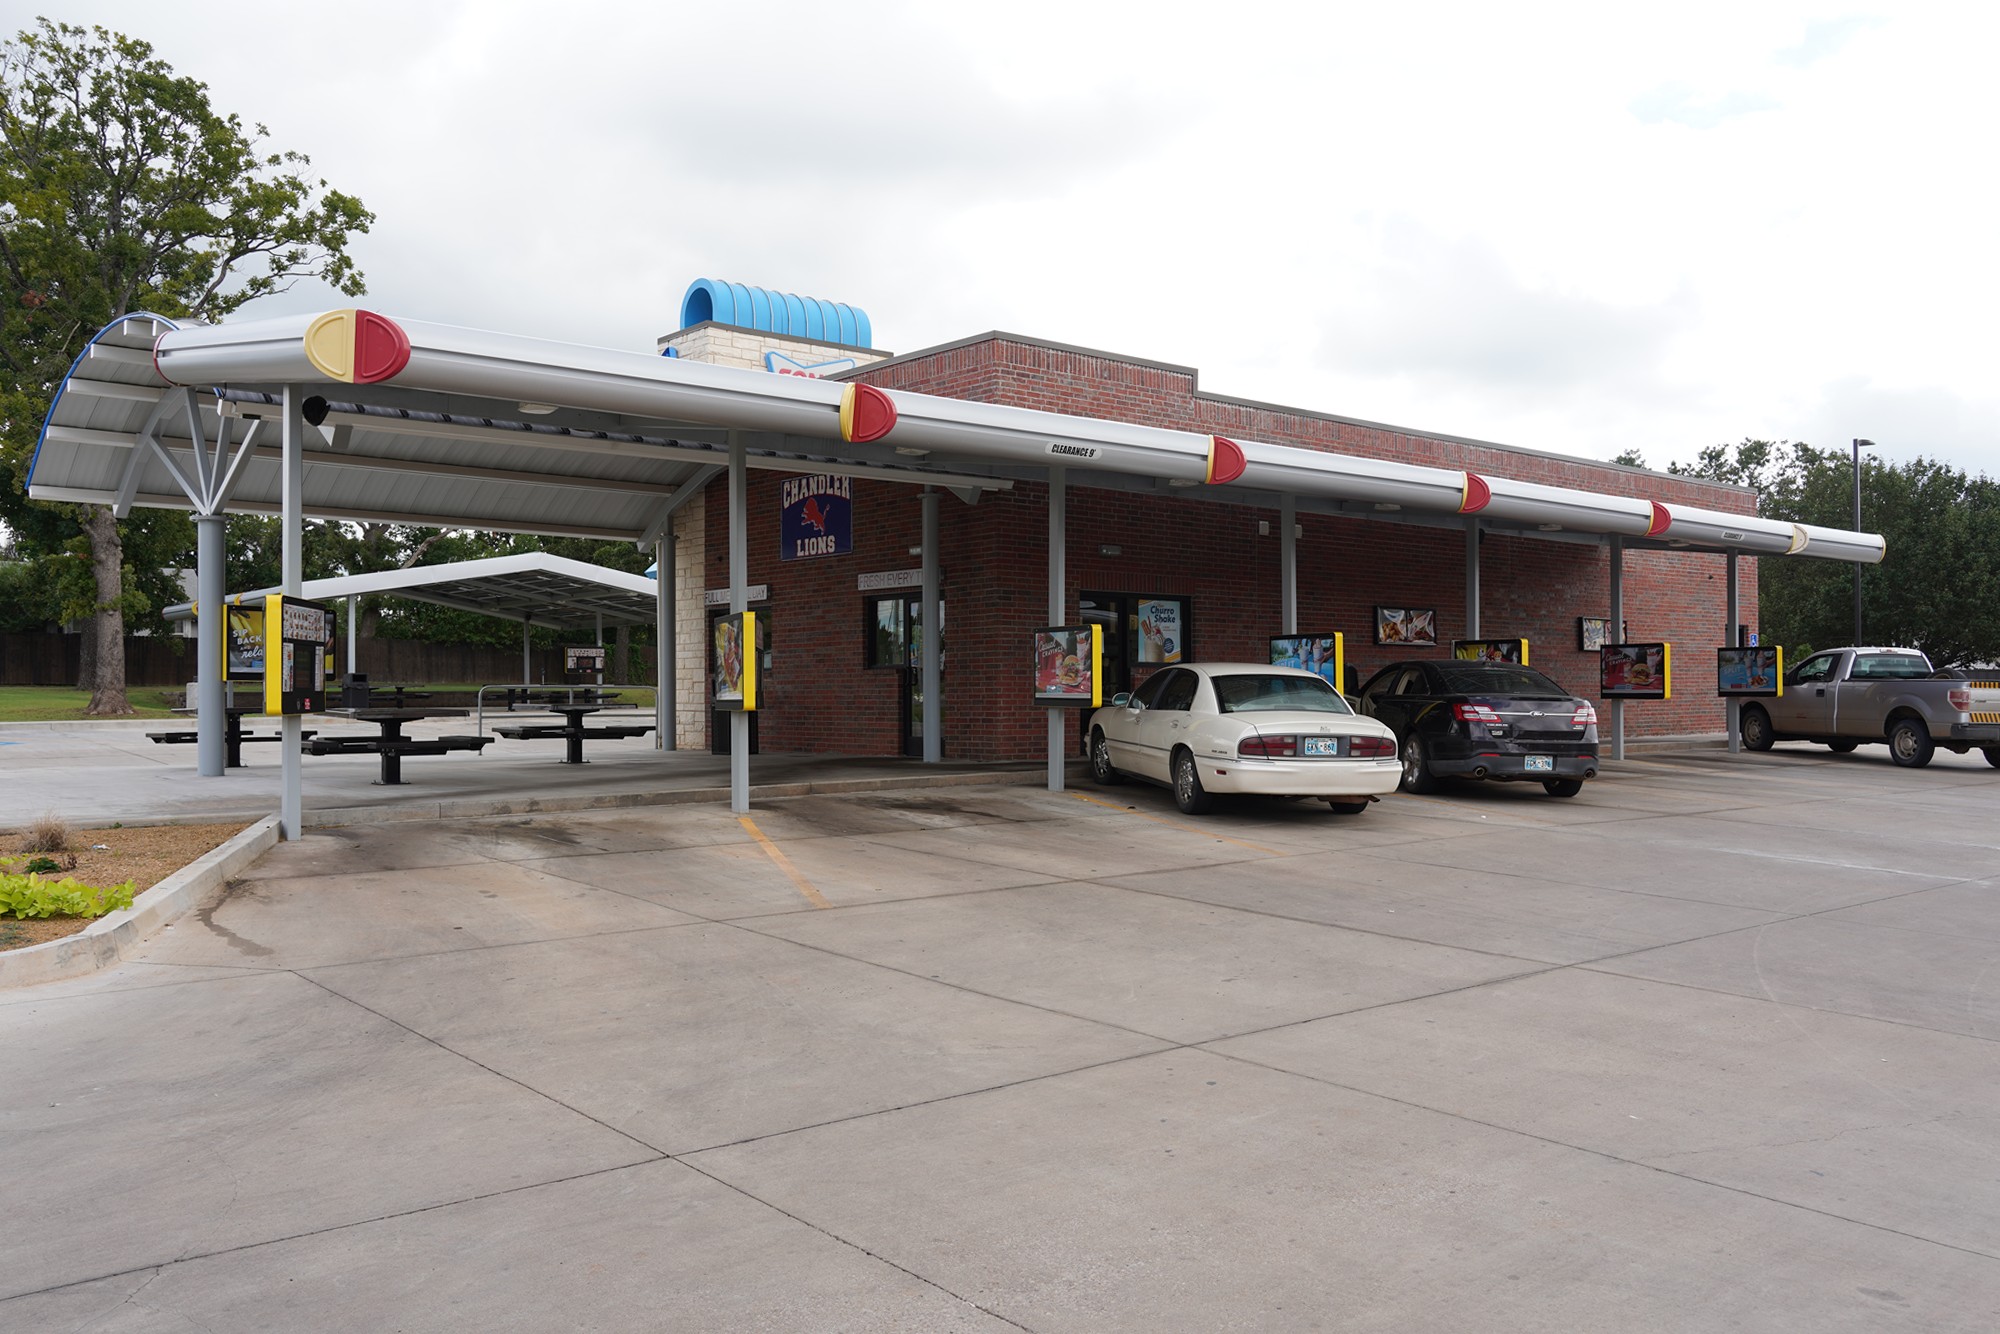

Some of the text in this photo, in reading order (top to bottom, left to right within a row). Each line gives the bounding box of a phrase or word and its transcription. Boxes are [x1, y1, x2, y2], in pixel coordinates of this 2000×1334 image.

[1051, 444, 1089, 457] CLEARANCE
[783, 475, 850, 509] CHANDLER
[797, 535, 836, 557] LIONS
[859, 574, 885, 588] FRESH
[887, 571, 914, 586] EVERY
[1151, 606, 1175, 615] Churro
[1154, 614, 1176, 623] Shake
[232, 628, 248, 638] SIP
[237, 635, 262, 645] BACK
[241, 645, 263, 659] rela
